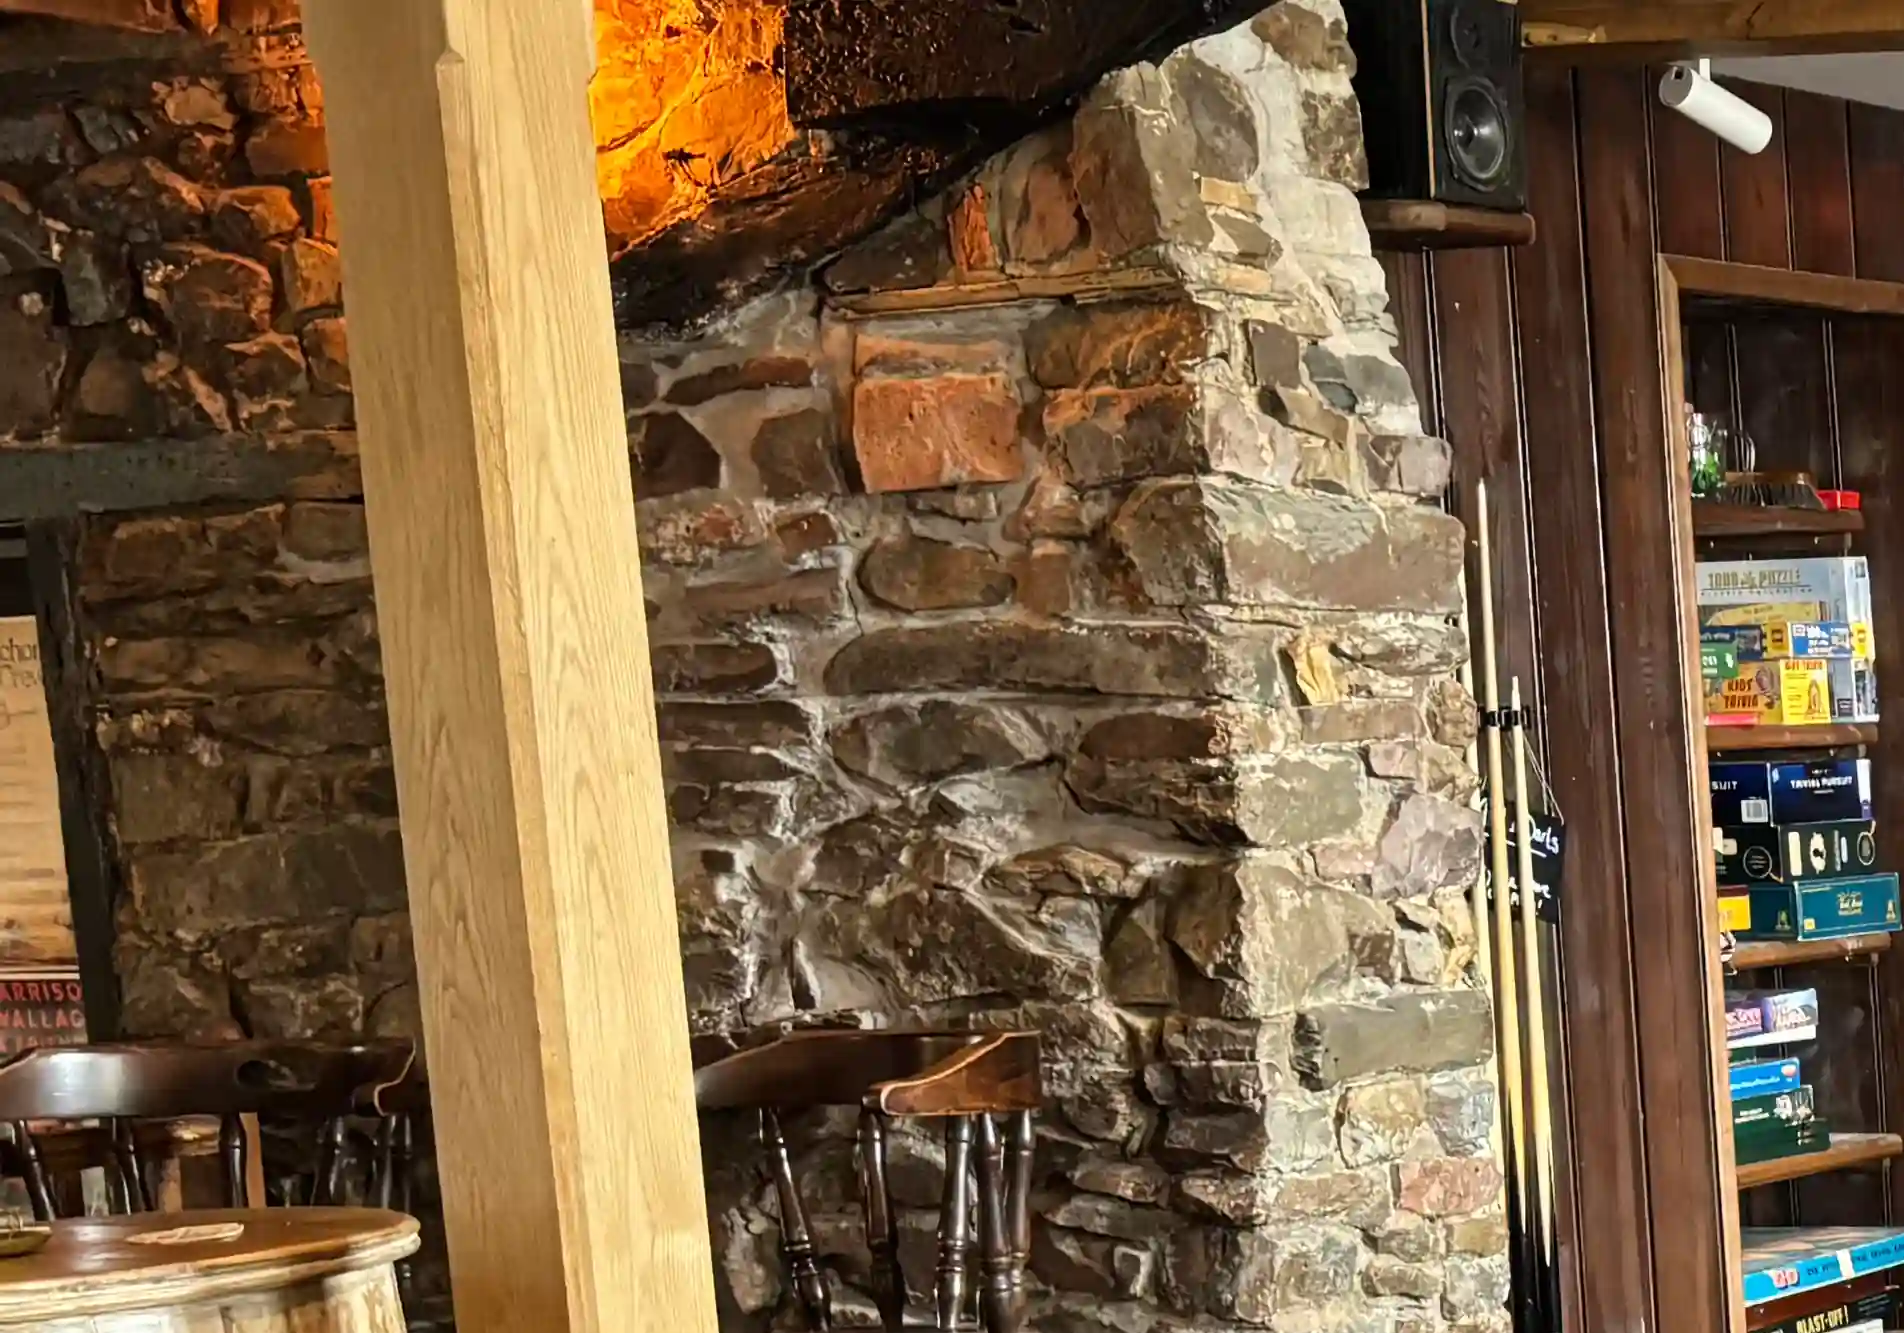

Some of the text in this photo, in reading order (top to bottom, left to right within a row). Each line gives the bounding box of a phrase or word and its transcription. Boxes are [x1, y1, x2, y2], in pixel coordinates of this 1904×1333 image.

[1727, 678, 1753, 693] KIDS
[1711, 780, 1738, 791] SUIT
[0, 982, 83, 1003] ARRISO
